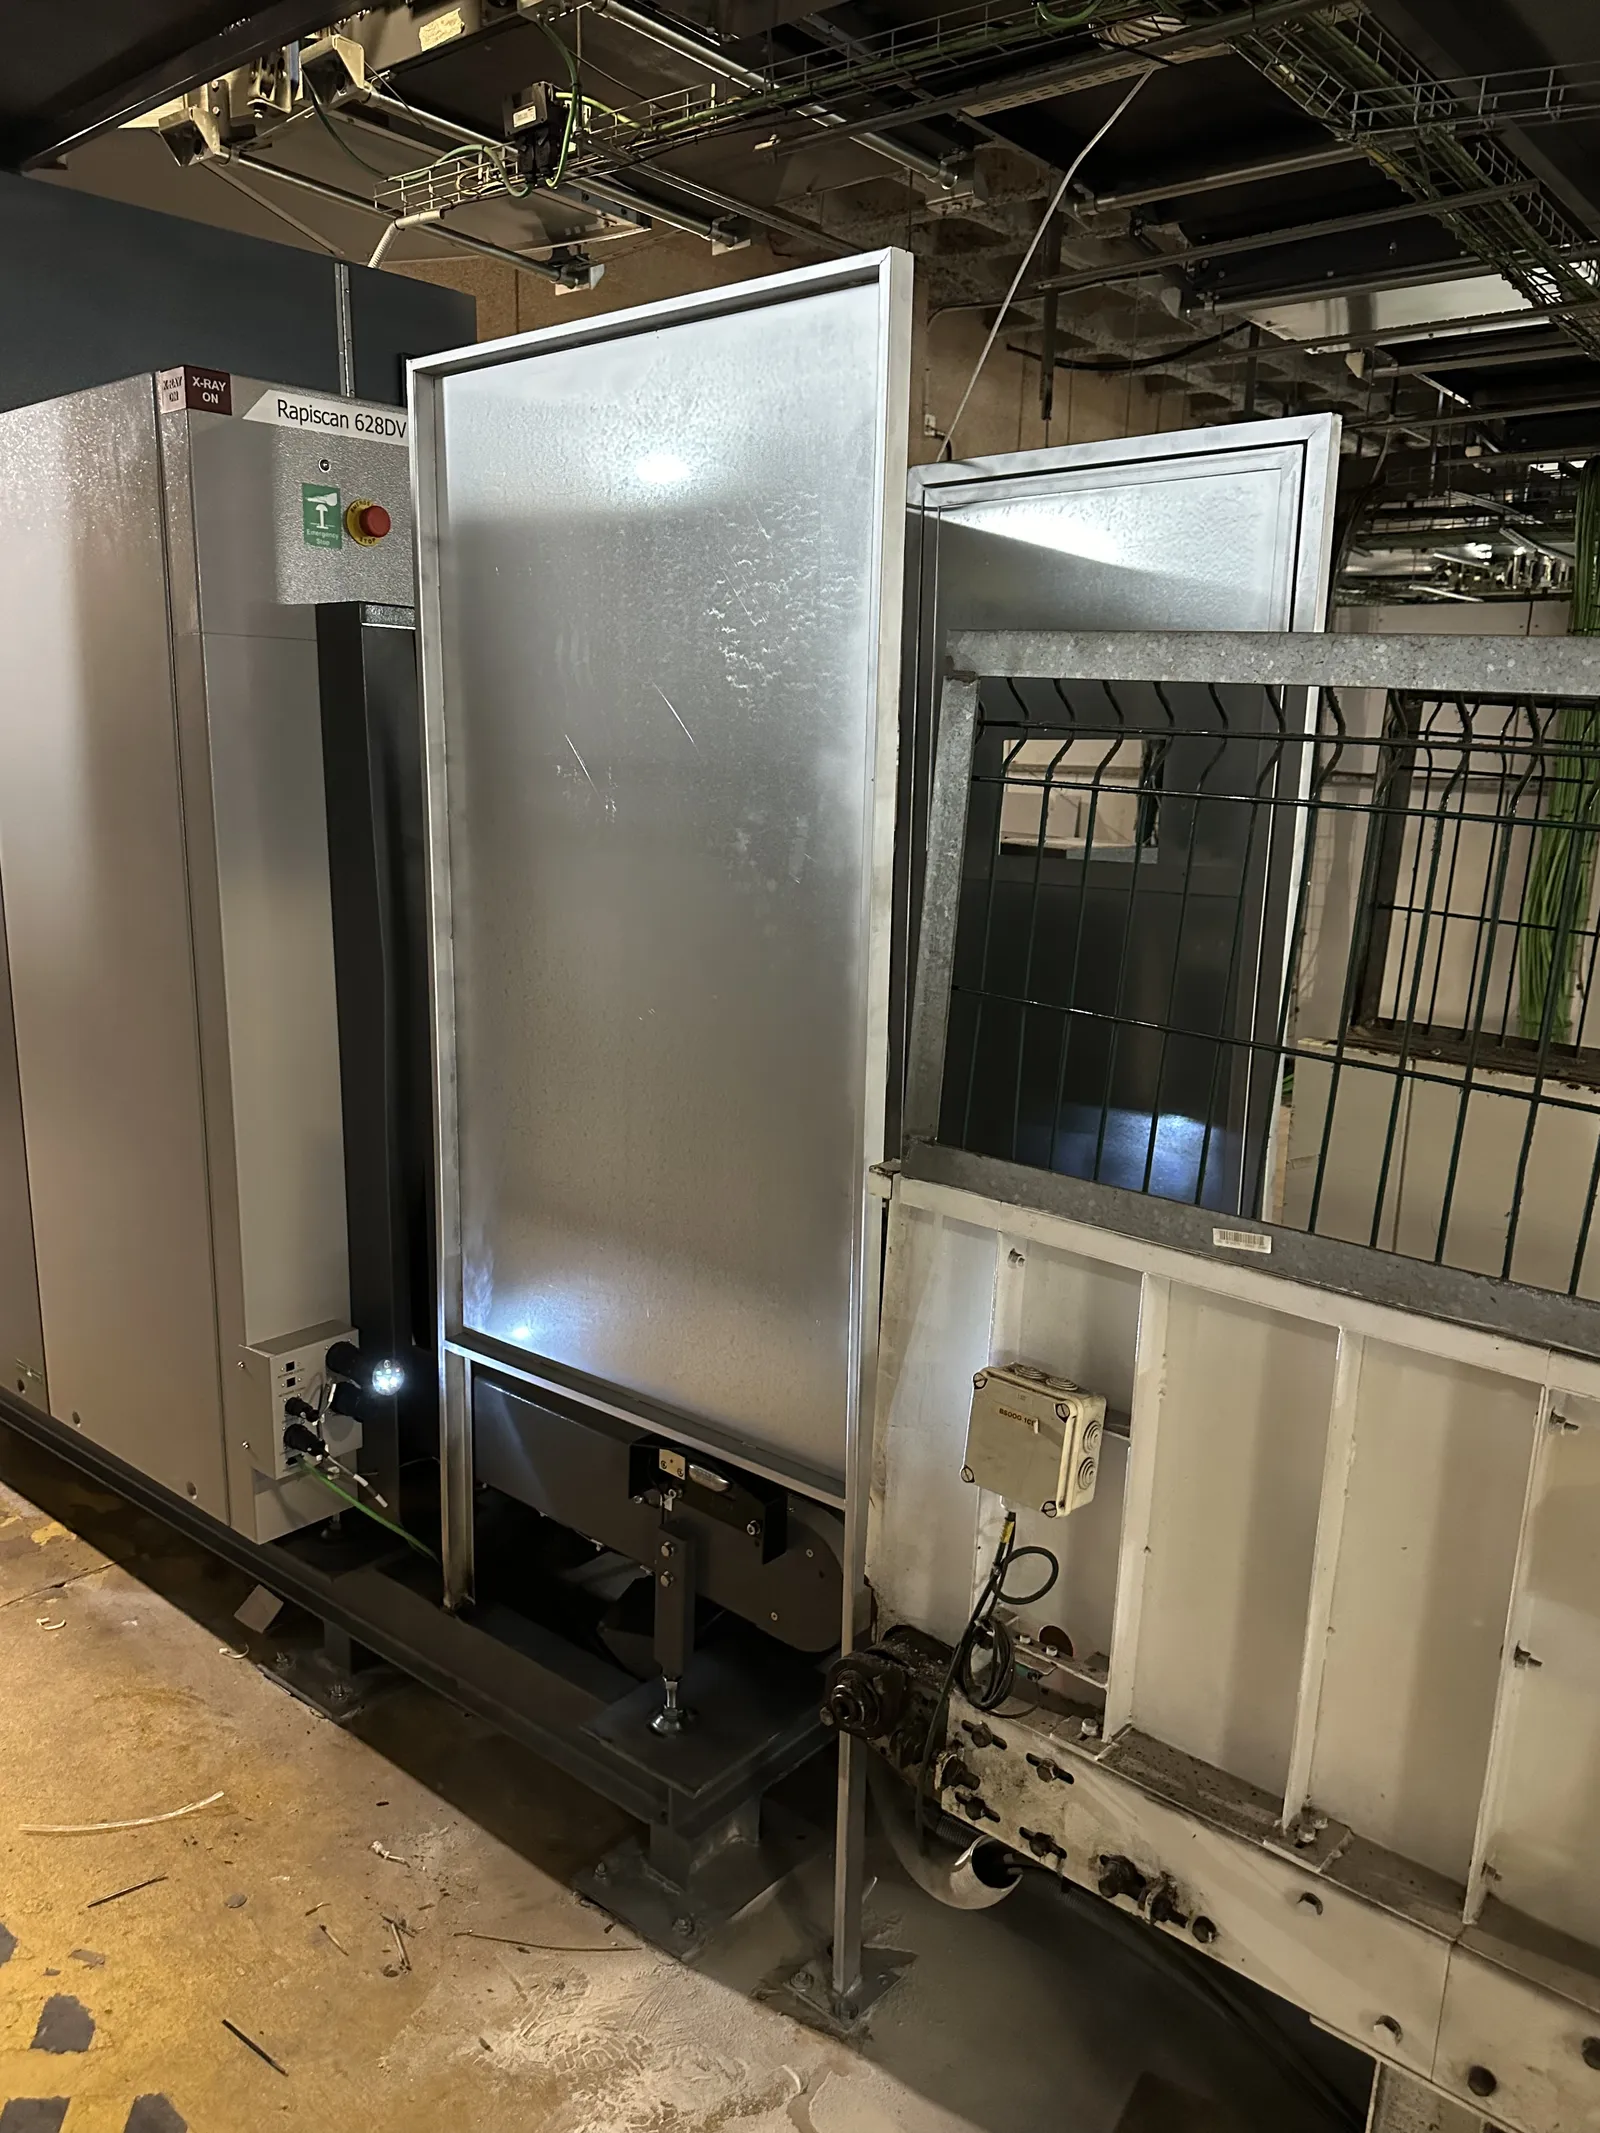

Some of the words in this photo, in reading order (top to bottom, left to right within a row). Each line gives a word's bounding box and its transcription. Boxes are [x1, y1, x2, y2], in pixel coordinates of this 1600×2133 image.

[192, 376, 226, 391] X-RAY
[202, 392, 219, 404] ON
[277, 399, 349, 429] Rapiscan
[355, 413, 407, 438] 628DV
[306, 529, 339, 541] Emergency
[315, 538, 330, 546] Stop
